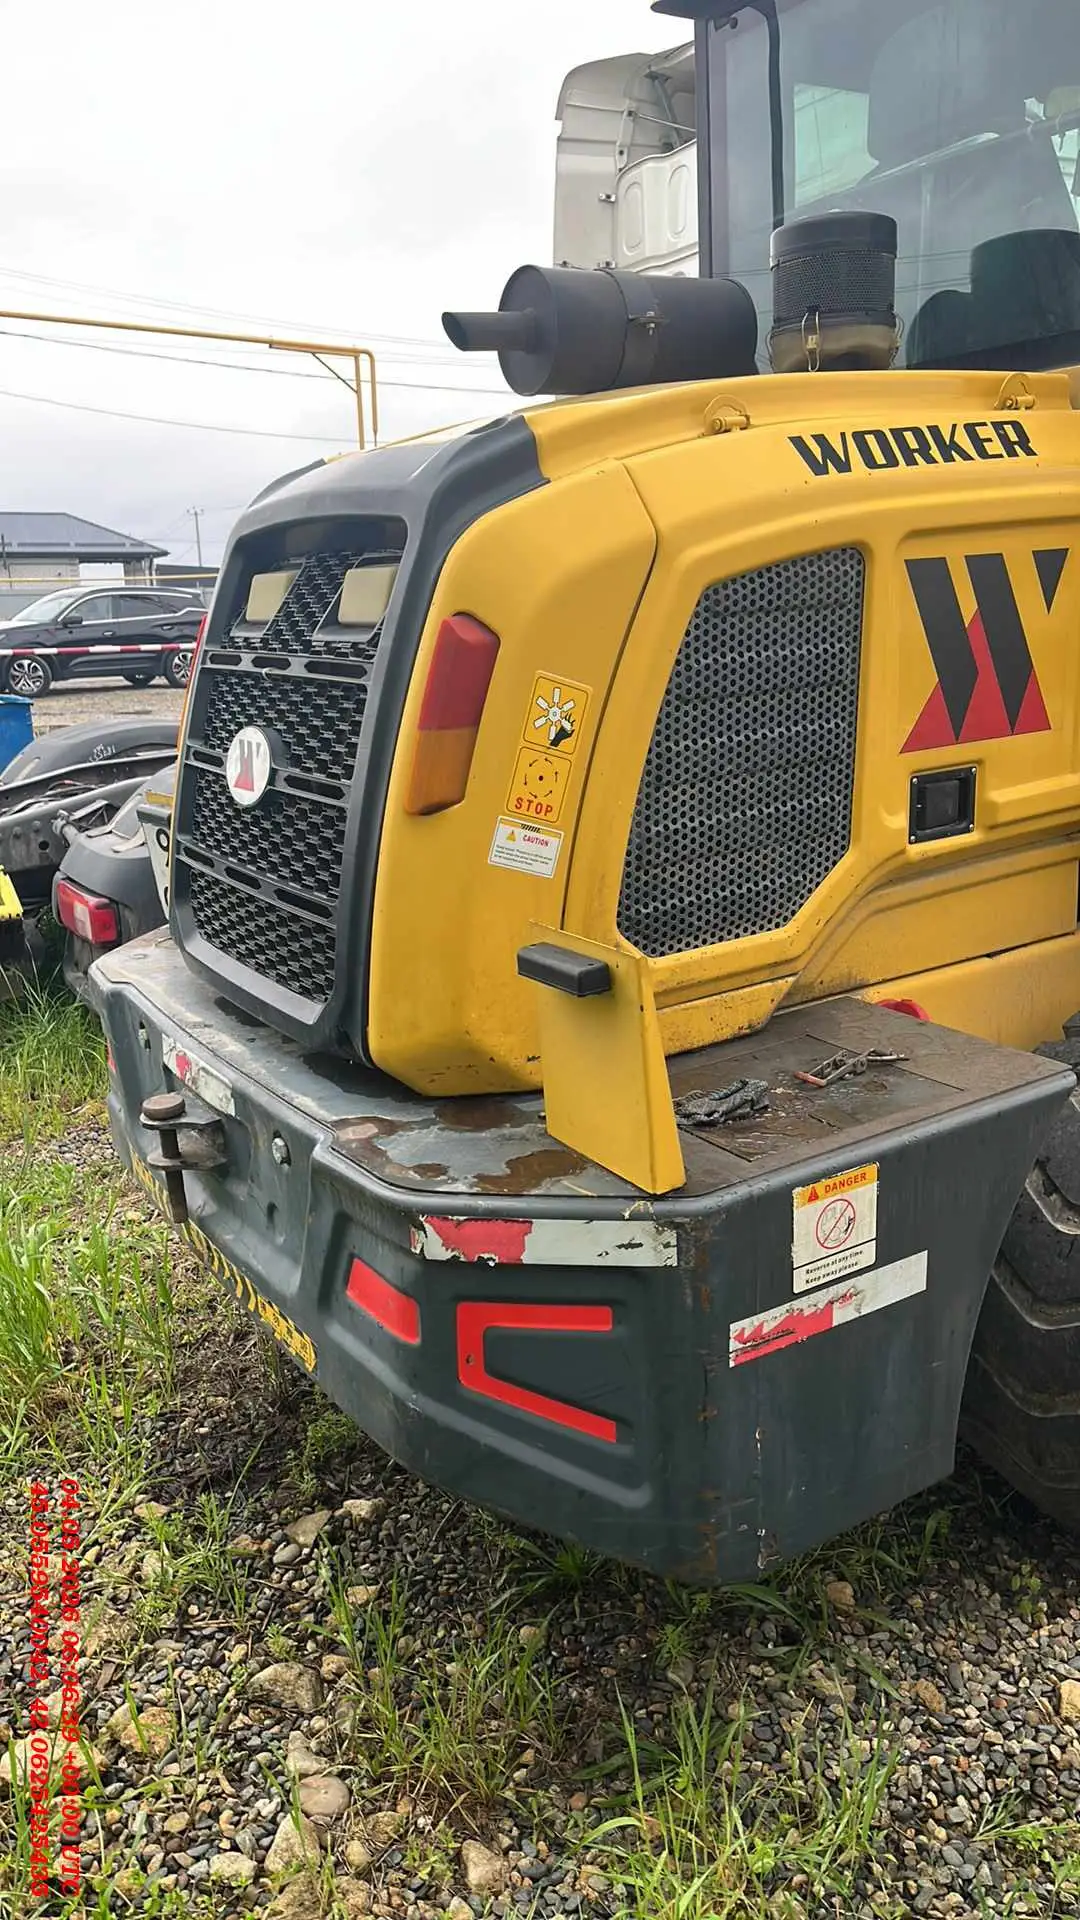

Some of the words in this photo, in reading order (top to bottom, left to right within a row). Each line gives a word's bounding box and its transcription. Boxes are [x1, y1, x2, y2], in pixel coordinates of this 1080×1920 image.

[787, 420, 1039, 476] WORKER
[515, 796, 553, 816] STOP
[522, 834, 549, 847] CAUTION
[824, 1171, 867, 1194] DANGER
[805, 1274, 821, 1284] Keep
